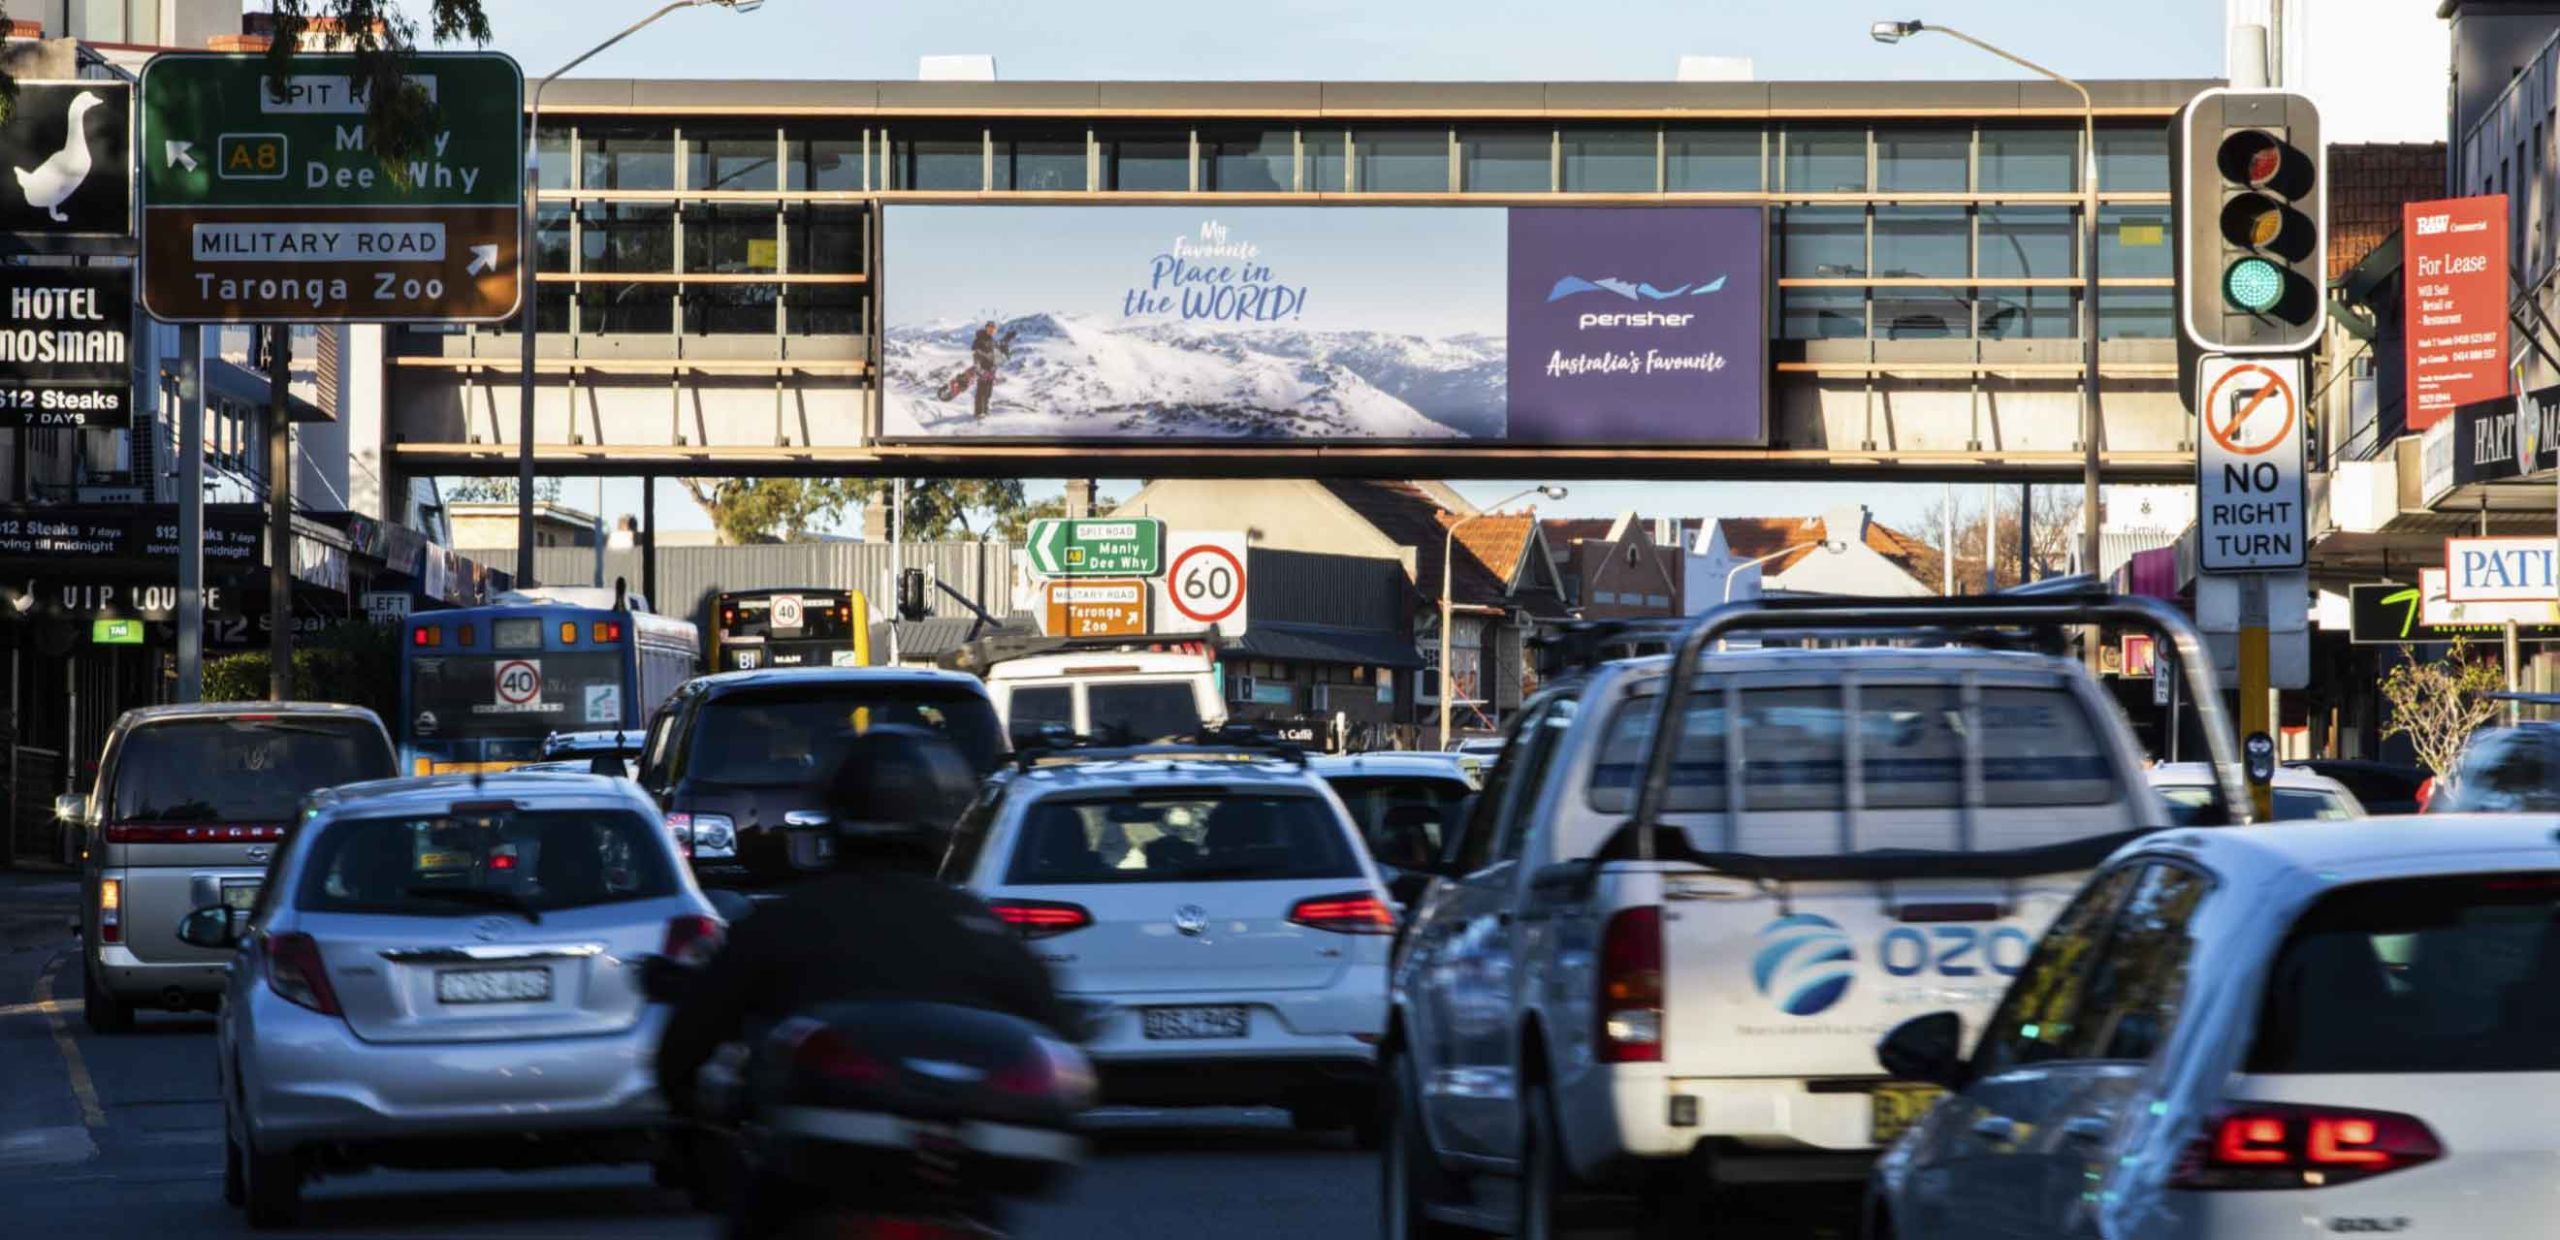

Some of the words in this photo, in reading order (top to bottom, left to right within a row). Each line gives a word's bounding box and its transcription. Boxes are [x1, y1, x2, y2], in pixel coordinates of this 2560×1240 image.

[230, 144, 276, 170] A8
[307, 160, 375, 189] Dee
[409, 160, 479, 194] Why
[201, 232, 341, 253] MILITARY
[357, 232, 437, 253] ROAD
[1200, 219, 1228, 244] My
[1172, 235, 1260, 260] Favourite
[1150, 253, 1237, 291] Place
[1241, 261, 1274, 283] in
[2418, 255, 2442, 277] For
[2444, 253, 2488, 275] Lease
[194, 272, 348, 309] Taronga
[373, 272, 444, 300] Zoo
[11, 286, 104, 320] HOTEL
[1124, 287, 1176, 318] the
[1180, 284, 1308, 323] WORLD!
[1578, 310, 1696, 331] perisher
[1546, 349, 1643, 379] Australia's
[1645, 348, 1727, 375] Favourite
[40, 389, 119, 409] Steaks
[25, 413, 34, 424] 7
[40, 413, 86, 425] DAYS
[2474, 412, 2515, 466] HART
[2224, 461, 2279, 495] NO
[2212, 501, 2293, 526] RIGHT
[0, 520, 20, 535] 12
[26, 520, 79, 536] Steaks
[1105, 526, 1134, 537] ROAD
[34, 539, 51, 550] till
[54, 539, 115, 554] midnight
[146, 544, 180, 555] servin
[1099, 542, 1140, 556] Manly
[2215, 533, 2292, 557] TURN
[1089, 556, 1115, 569] Dee
[1120, 556, 1149, 570] Why
[1184, 566, 1232, 600] 60
[132, 586, 220, 611] LOUE
[1055, 590, 1102, 600] MILITARY
[1107, 590, 1136, 600] ROAD
[778, 606, 795, 618] 40
[1069, 605, 1123, 620] Taronga
[110, 625, 127, 636] TAB
[1081, 619, 1108, 632] Zoo
[503, 671, 534, 693] 40
